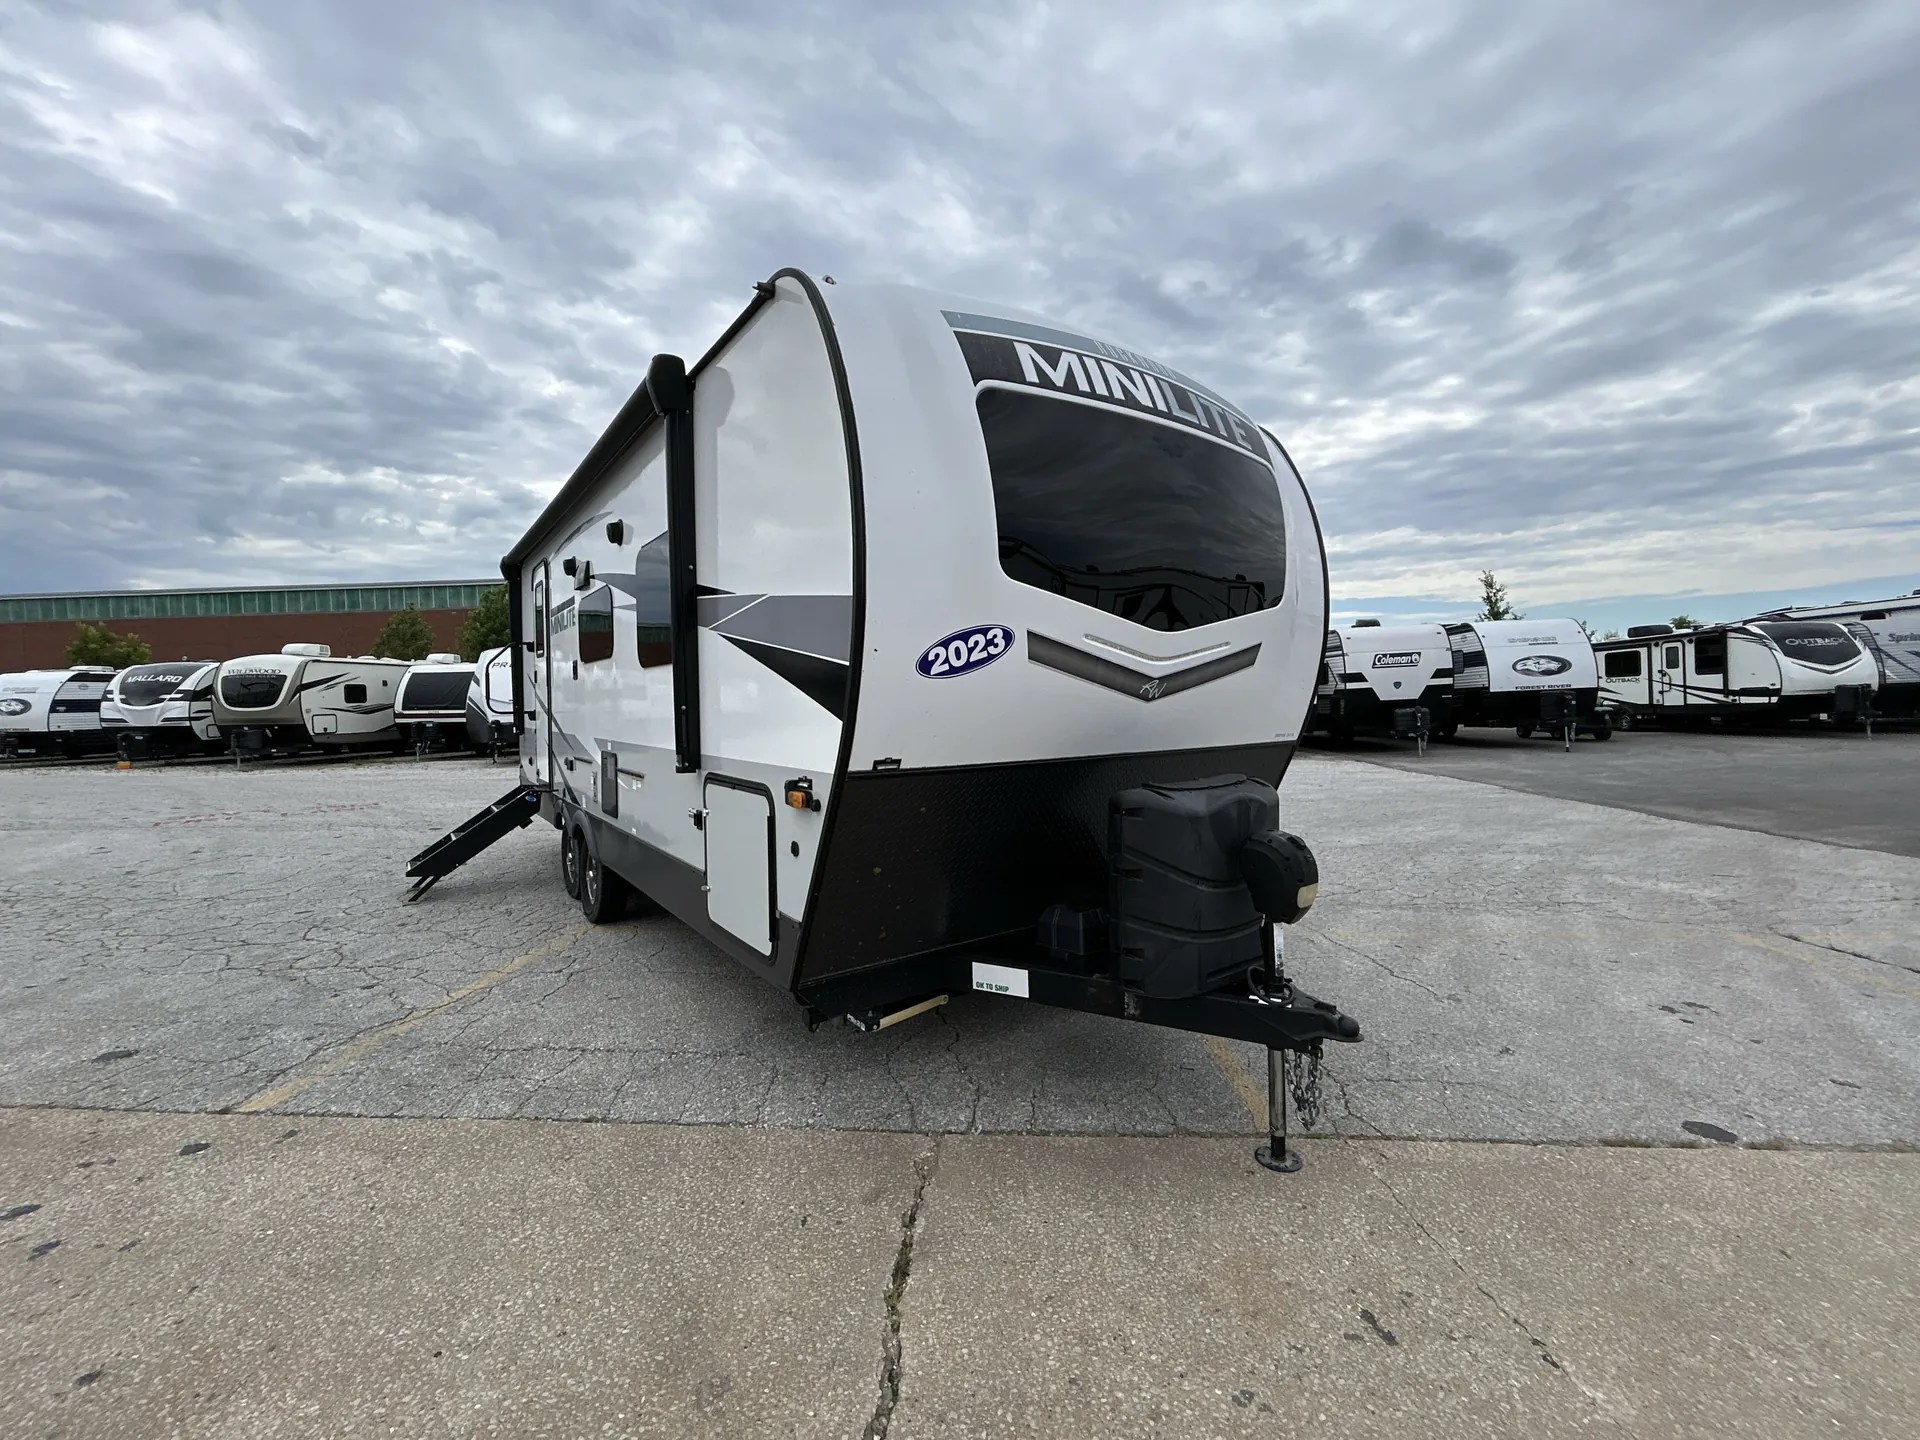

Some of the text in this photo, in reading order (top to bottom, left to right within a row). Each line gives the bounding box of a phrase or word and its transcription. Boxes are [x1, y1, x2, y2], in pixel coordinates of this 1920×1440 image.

[1012, 340, 1253, 450] MINILITE
[1785, 637, 1848, 645] OUTBACK
[928, 628, 1005, 675] 2023
[1374, 653, 1412, 665] Coleman
[125, 674, 183, 683] MALLARD
[976, 981, 1009, 992] OK TO SHIP
